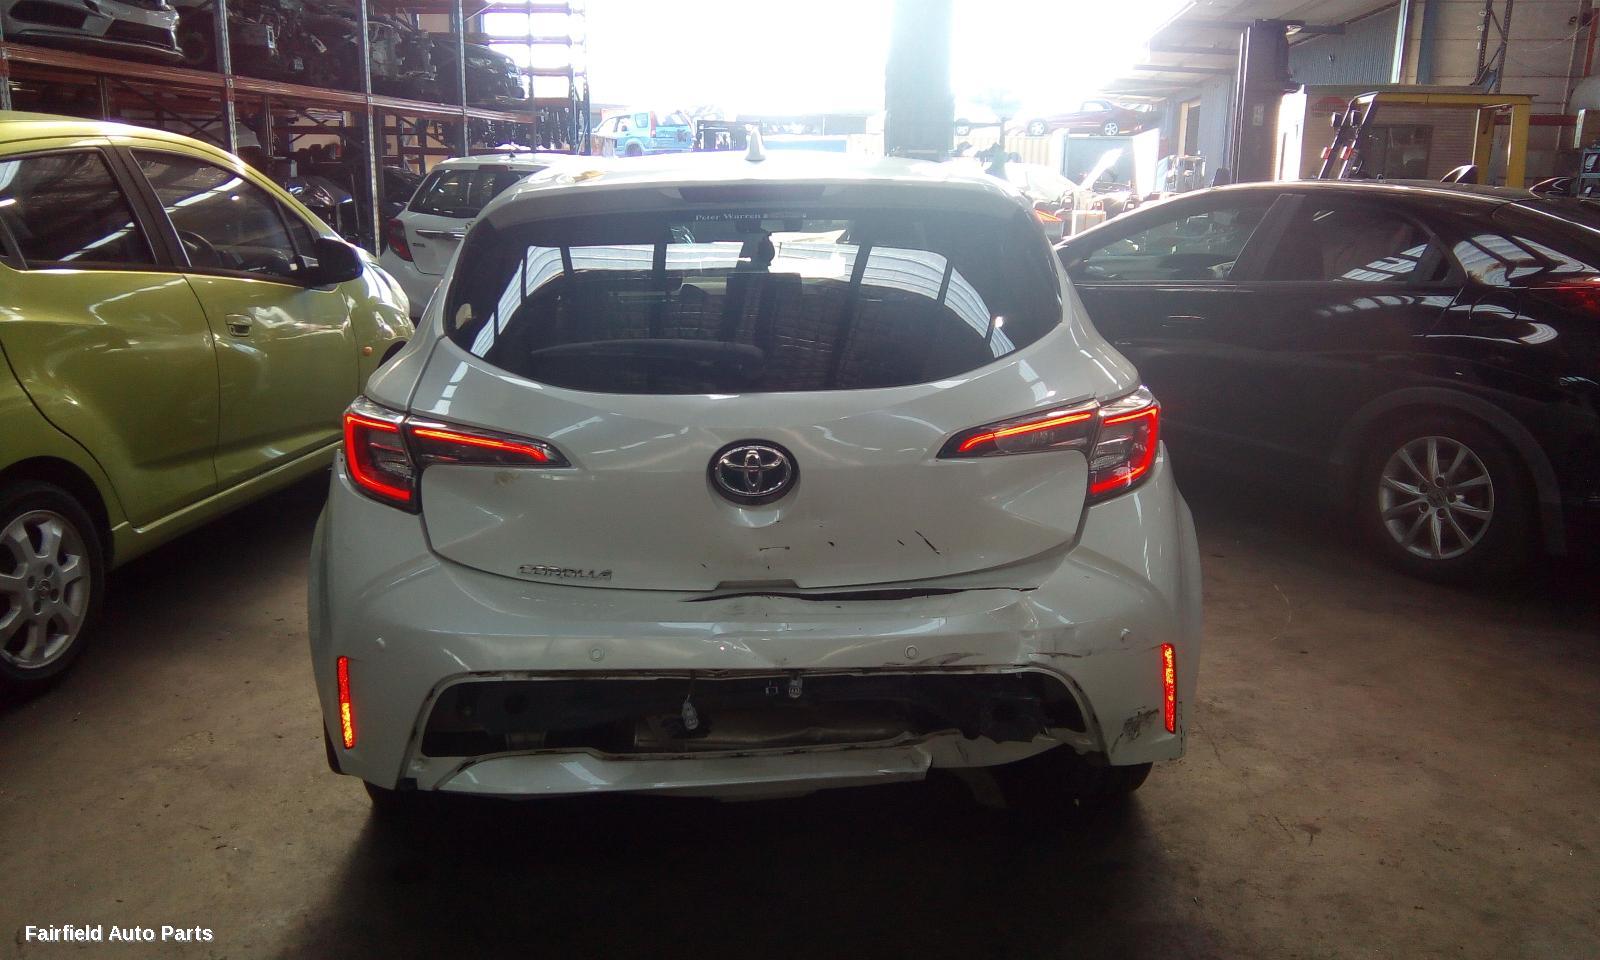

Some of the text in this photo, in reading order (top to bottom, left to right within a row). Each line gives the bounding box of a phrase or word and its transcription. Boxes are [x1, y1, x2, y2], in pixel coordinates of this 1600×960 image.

[695, 213, 720, 221] Peter
[723, 212, 761, 220] Warren
[519, 564, 613, 581] COROLLA
